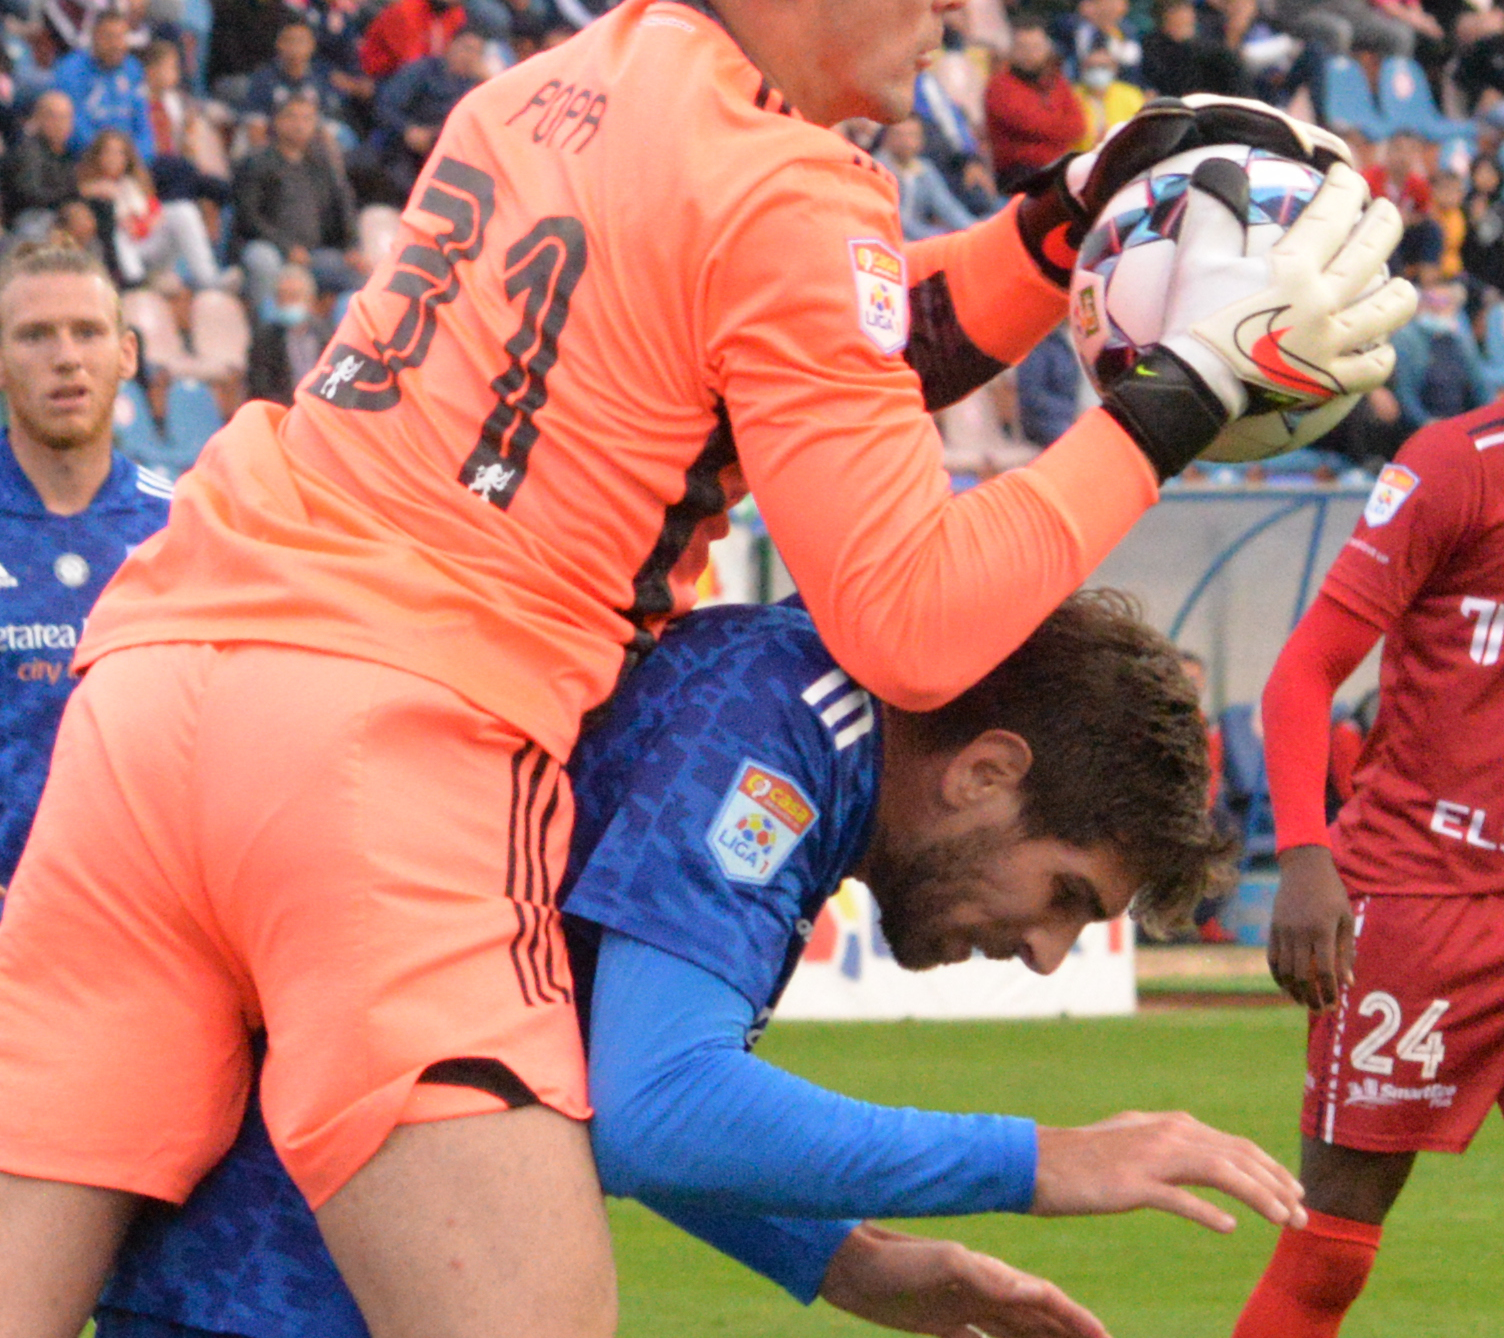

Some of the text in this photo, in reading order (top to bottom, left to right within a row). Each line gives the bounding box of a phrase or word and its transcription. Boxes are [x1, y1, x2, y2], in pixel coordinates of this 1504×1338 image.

[504, 78, 608, 155] POPA
[296, 156, 589, 511] 31
[718, 829, 759, 868] LIGA
[1350, 991, 1451, 1079] 24
